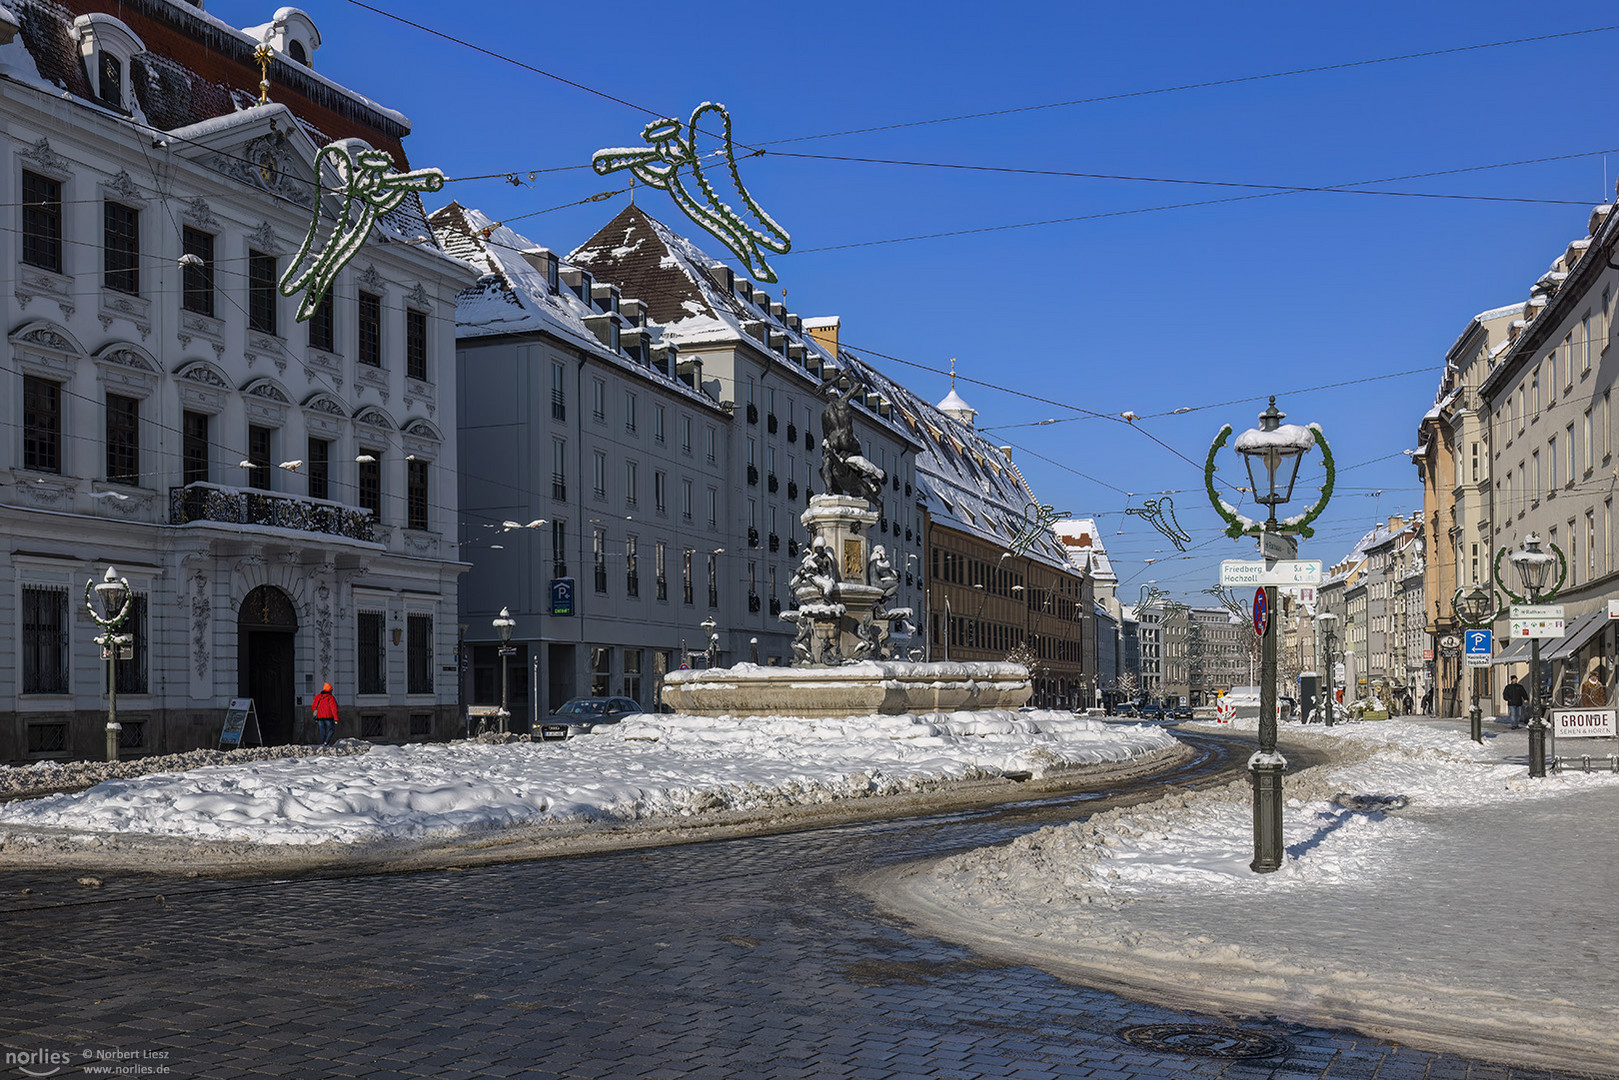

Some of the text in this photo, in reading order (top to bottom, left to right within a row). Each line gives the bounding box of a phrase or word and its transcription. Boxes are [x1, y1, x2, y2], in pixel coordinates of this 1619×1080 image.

[1224, 565, 1262, 574] Friedberg
[558, 587, 567, 599] P
[1475, 636, 1483, 646] P
[1561, 714, 1608, 727] GRONDE
